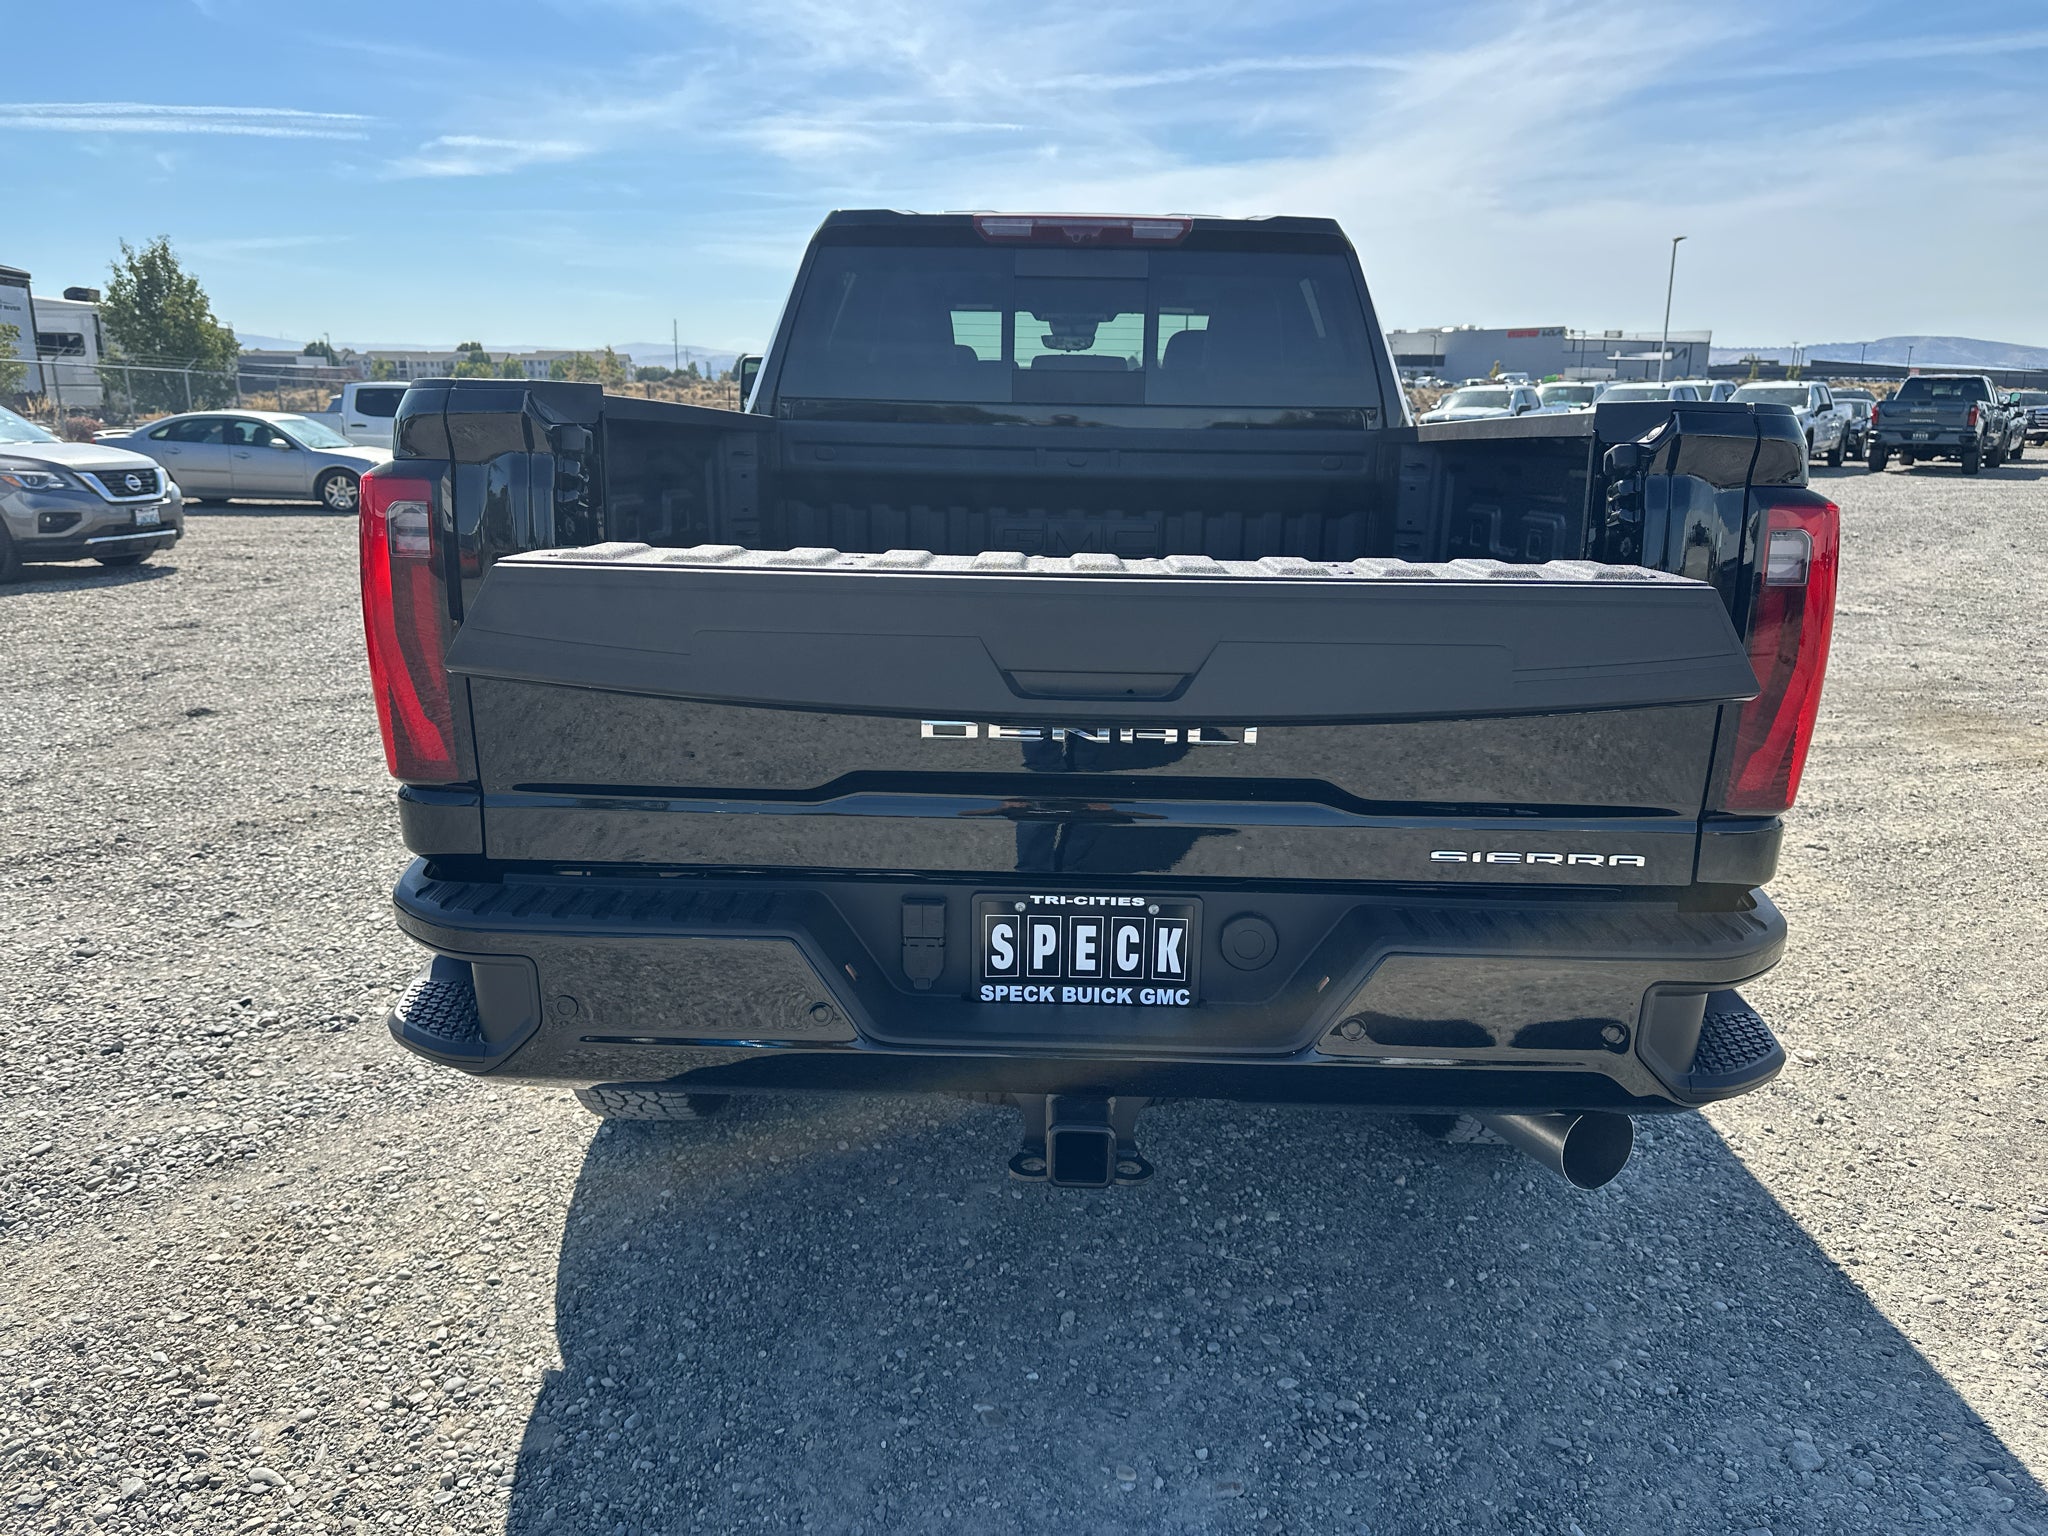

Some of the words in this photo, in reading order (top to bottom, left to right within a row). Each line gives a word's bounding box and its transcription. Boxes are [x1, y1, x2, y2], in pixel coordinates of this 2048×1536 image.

[993, 519, 1158, 554] GMC
[920, 720, 1258, 745] DENALI
[1430, 850, 1646, 867] SIERRA
[1029, 895, 1145, 906] TRI-CITIES
[990, 923, 1182, 974] SPECK
[980, 985, 1055, 1002] SPECK
[1062, 986, 1133, 1004] BUICK
[1139, 988, 1190, 1005] GMC
